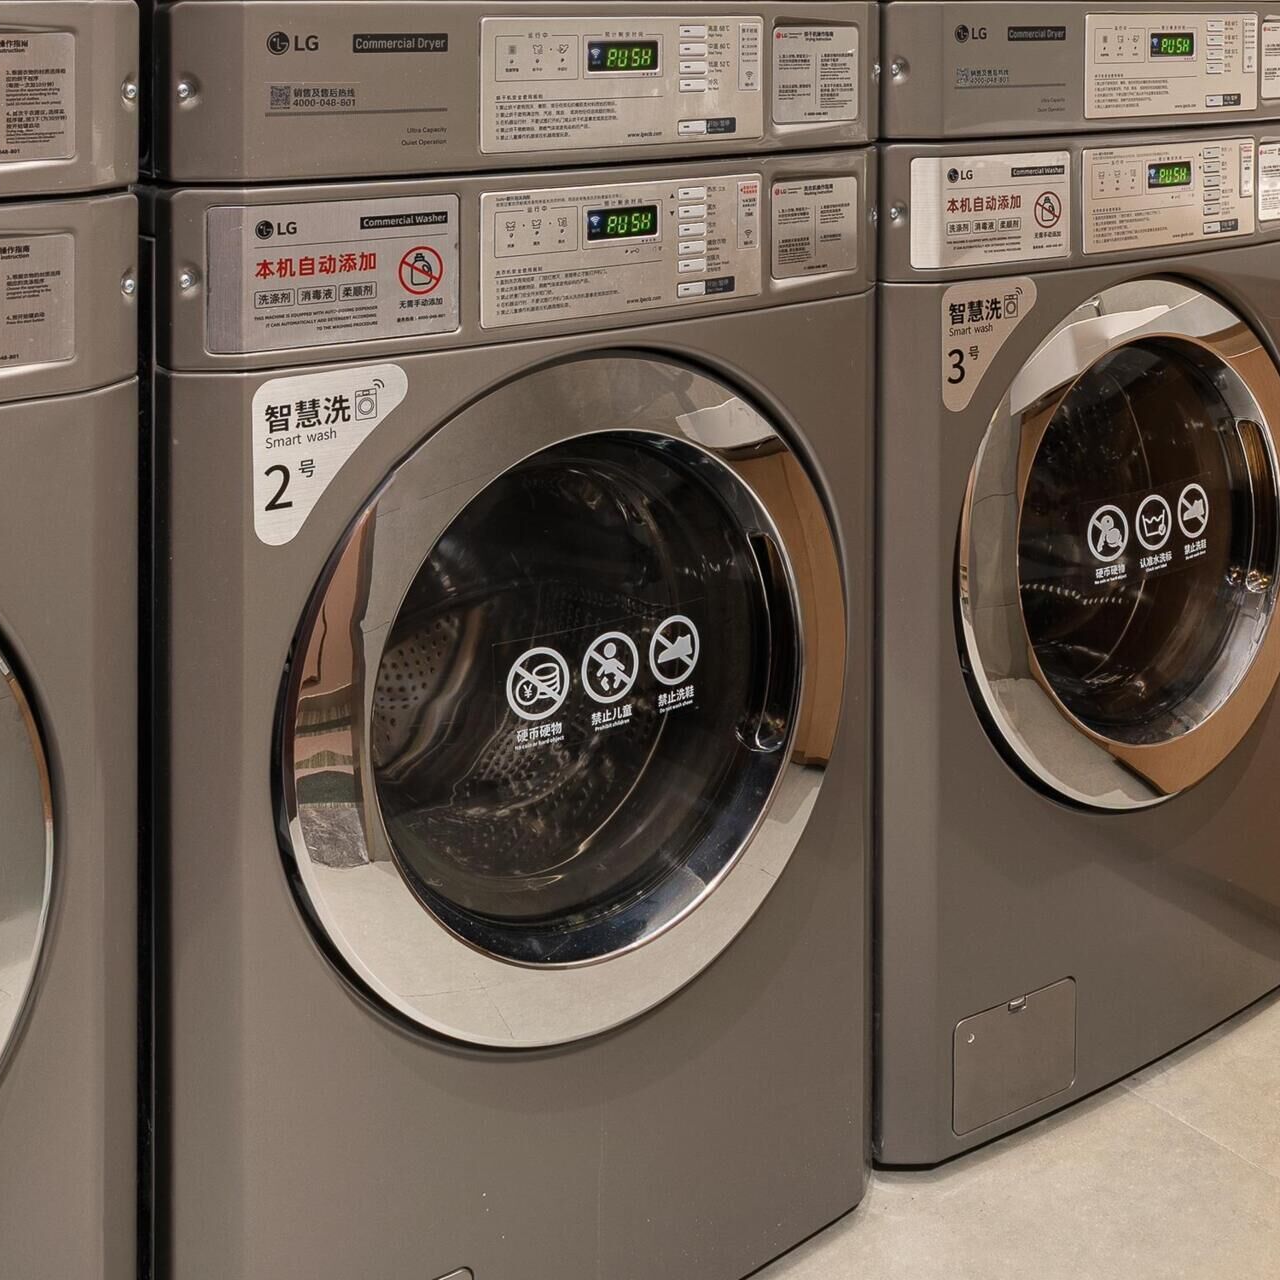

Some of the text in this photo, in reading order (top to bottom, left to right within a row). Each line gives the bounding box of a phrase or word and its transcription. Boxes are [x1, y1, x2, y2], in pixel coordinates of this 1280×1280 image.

[294, 36, 445, 51] LG Commercial Dryer
[972, 28, 1064, 40] LG Commercial Dryer
[607, 49, 651, 67] PUSH
[961, 170, 973, 180] LG
[947, 195, 1021, 214] 本机自动添加
[277, 213, 446, 235] LG Commercial Washer
[607, 213, 651, 233] PUSH
[255, 252, 376, 280] 本机自动添加
[258, 285, 373, 305] 洗涤剂 消毒液 柔顺剂
[949, 298, 1001, 325] 智慧洗
[949, 323, 993, 337] Smart wash
[948, 345, 979, 384] 3 号
[265, 395, 351, 434] 智慧洗
[266, 428, 337, 449] Smart wash
[264, 459, 315, 511] 2 号
[658, 685, 694, 707] 禁止洗鞋
[591, 704, 632, 726] 禁止儿童
